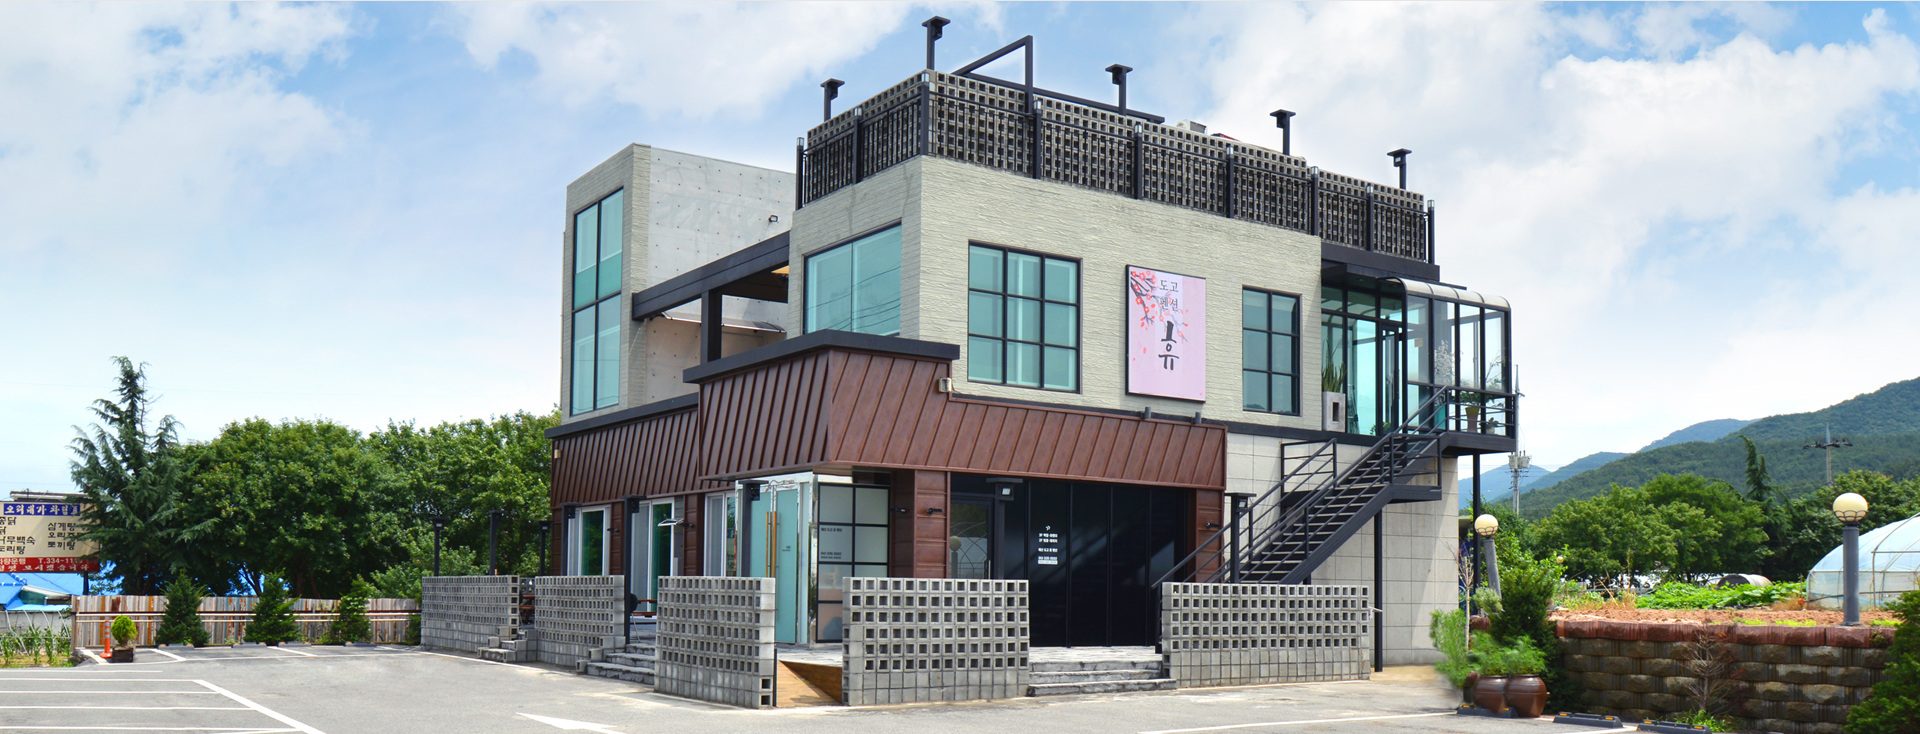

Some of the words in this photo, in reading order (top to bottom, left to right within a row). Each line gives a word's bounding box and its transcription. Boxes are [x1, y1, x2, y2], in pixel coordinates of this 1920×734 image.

[1159, 279, 1179, 292] 도고
[1159, 296, 1179, 312] 펜션
[1158, 320, 1179, 371] 휴
